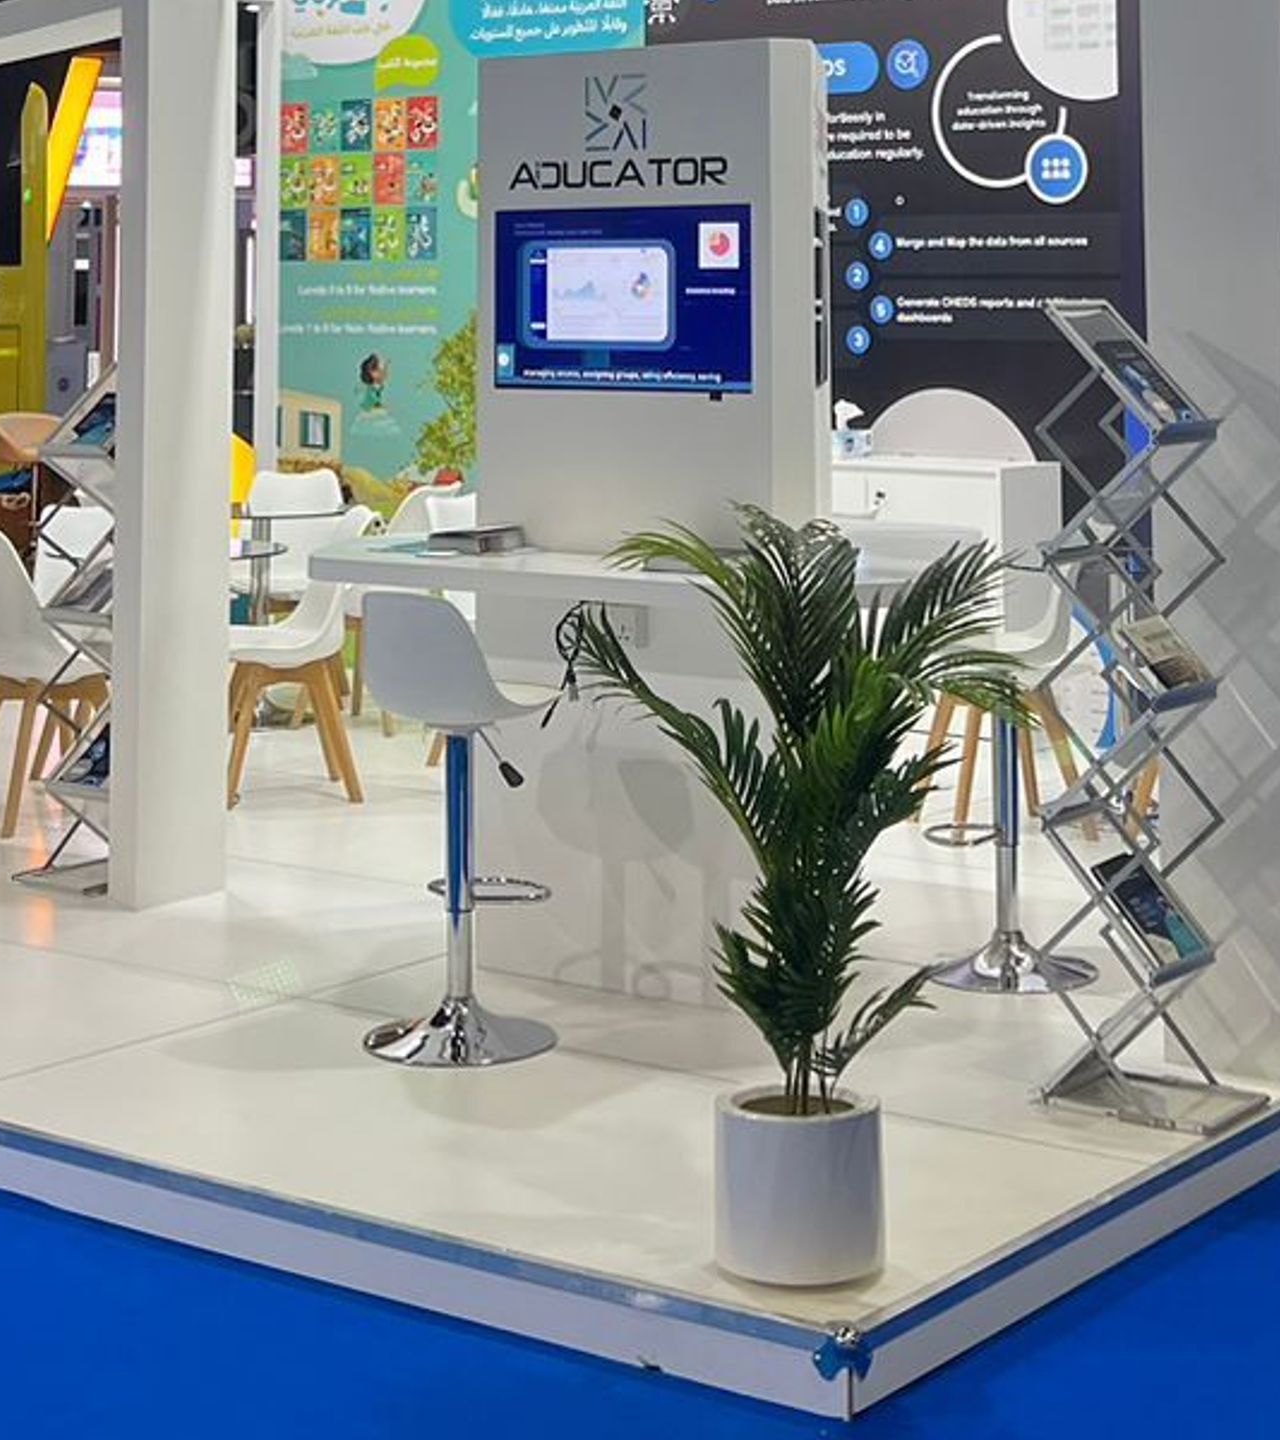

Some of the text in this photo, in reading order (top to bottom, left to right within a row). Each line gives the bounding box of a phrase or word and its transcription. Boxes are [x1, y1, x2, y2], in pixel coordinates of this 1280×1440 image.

[957, 103, 1042, 116] education through
[837, 128, 881, 144] required
[884, 128, 895, 140] to
[897, 128, 912, 140] be
[827, 148, 872, 160] ducation
[896, 237, 924, 250] Merge
[927, 236, 944, 248] and
[968, 236, 984, 248] the
[985, 236, 1008, 247] data
[1009, 236, 1032, 247] from
[1047, 236, 1088, 247] sources
[896, 296, 939, 308] Generate
[979, 297, 1013, 310] reports
[1016, 296, 1035, 308] and
